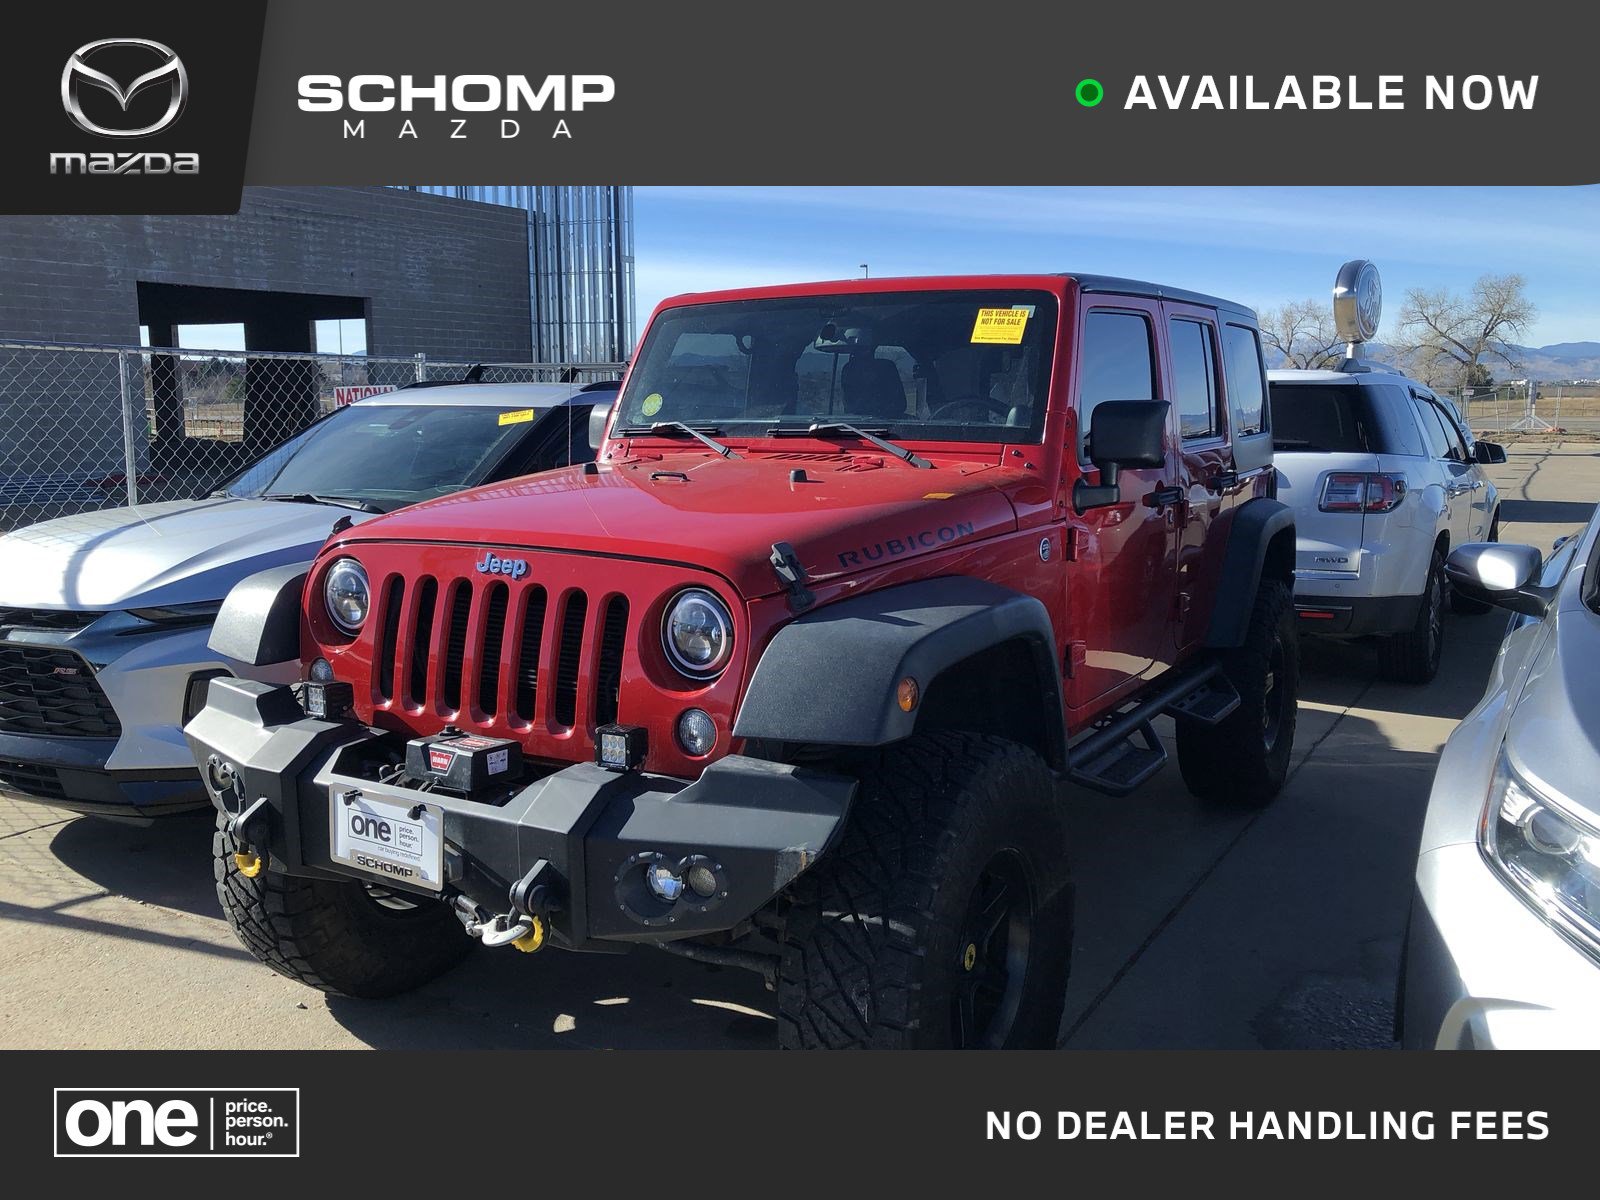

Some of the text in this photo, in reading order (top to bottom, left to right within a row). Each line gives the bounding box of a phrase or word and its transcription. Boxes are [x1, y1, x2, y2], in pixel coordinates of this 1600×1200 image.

[1006, 318, 1021, 326] SALE
[838, 521, 975, 568] RUBICON
[476, 551, 527, 579] Jeep
[351, 815, 391, 842] one
[357, 855, 413, 877] SCHOMP
